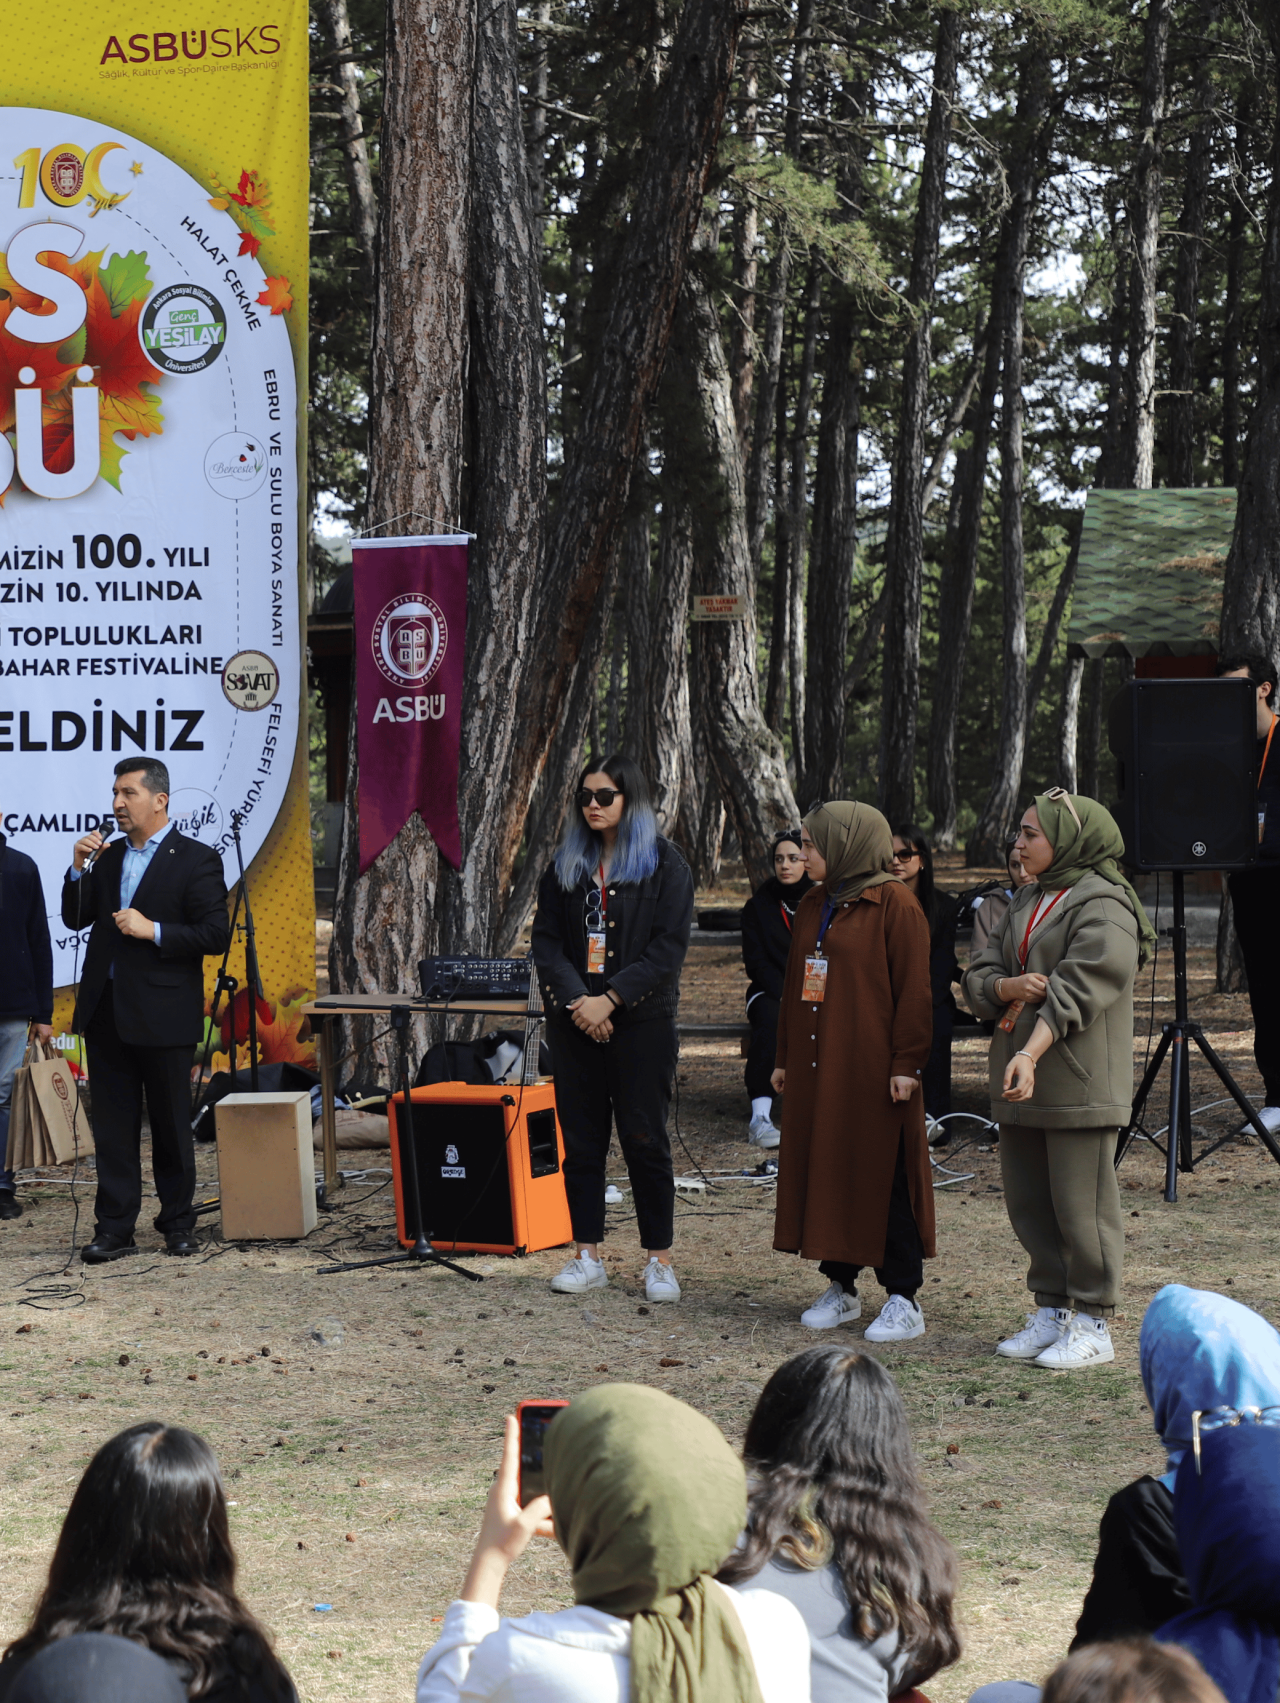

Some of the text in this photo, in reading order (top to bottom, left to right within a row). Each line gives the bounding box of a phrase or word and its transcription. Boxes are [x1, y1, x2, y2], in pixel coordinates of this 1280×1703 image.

[99, 24, 281, 65] ASBÜSKS
[99, 70, 131, 81] Sağlık,
[132, 67, 162, 77] Kültür
[177, 65, 201, 76] Spor
[202, 63, 229, 73] Daire
[230, 60, 280, 72] Başkanlığı
[180, 215, 262, 332] HALAT ÇEKME
[152, 286, 215, 310] Ankara Sosyal Bilimler
[170, 311, 198, 323] Genç
[164, 357, 207, 372] Üniversitesi
[263, 369, 283, 646] EBRU VE SULU BOYA SANATI
[73, 533, 155, 569] 100.
[163, 547, 209, 567] YILI
[56, 582, 88, 602] 10.
[95, 580, 202, 602] YILINDA
[373, 609, 390, 648] SOSYAL
[393, 595, 437, 613] BİLİMLER
[8, 624, 202, 646] TOPLULUKLARI
[77, 652, 223, 676] FESTİVALİNE
[372, 693, 446, 724] ASBÜ
[256, 702, 282, 775] FELSEFİ
[3, 813, 124, 837] ÇAMLIDE
